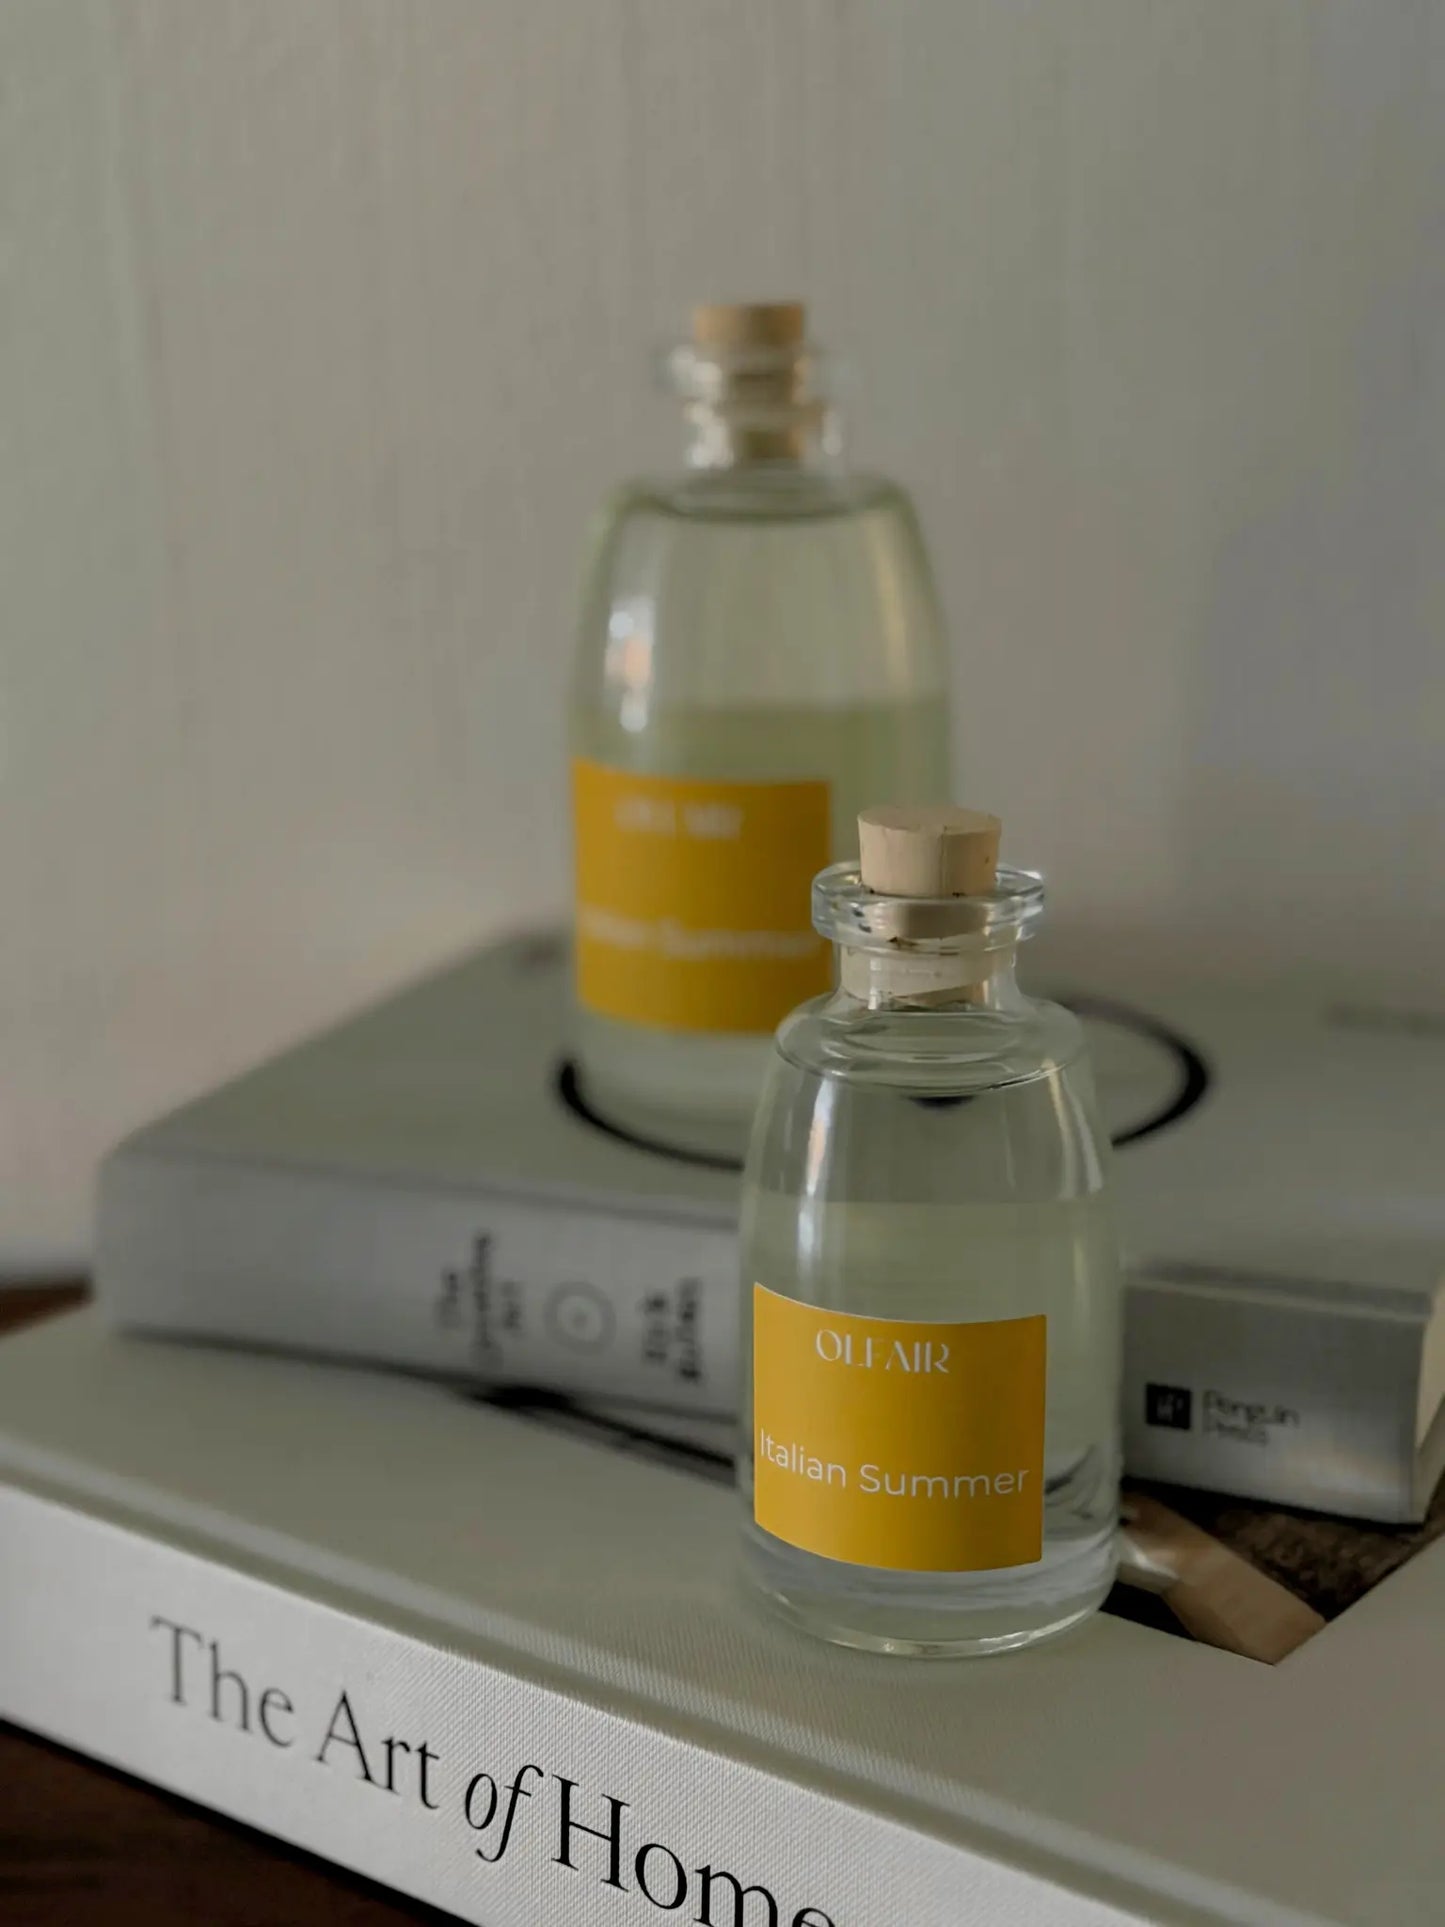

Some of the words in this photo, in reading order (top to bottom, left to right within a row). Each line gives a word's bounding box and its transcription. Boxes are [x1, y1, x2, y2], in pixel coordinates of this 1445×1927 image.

[816, 1330, 950, 1373] OLFAIR
[760, 1429, 847, 1488] Italian
[860, 1464, 1030, 1499] Summer
[151, 1616, 295, 1747] The
[316, 1690, 442, 1809] Art
[464, 1764, 544, 1862] of
